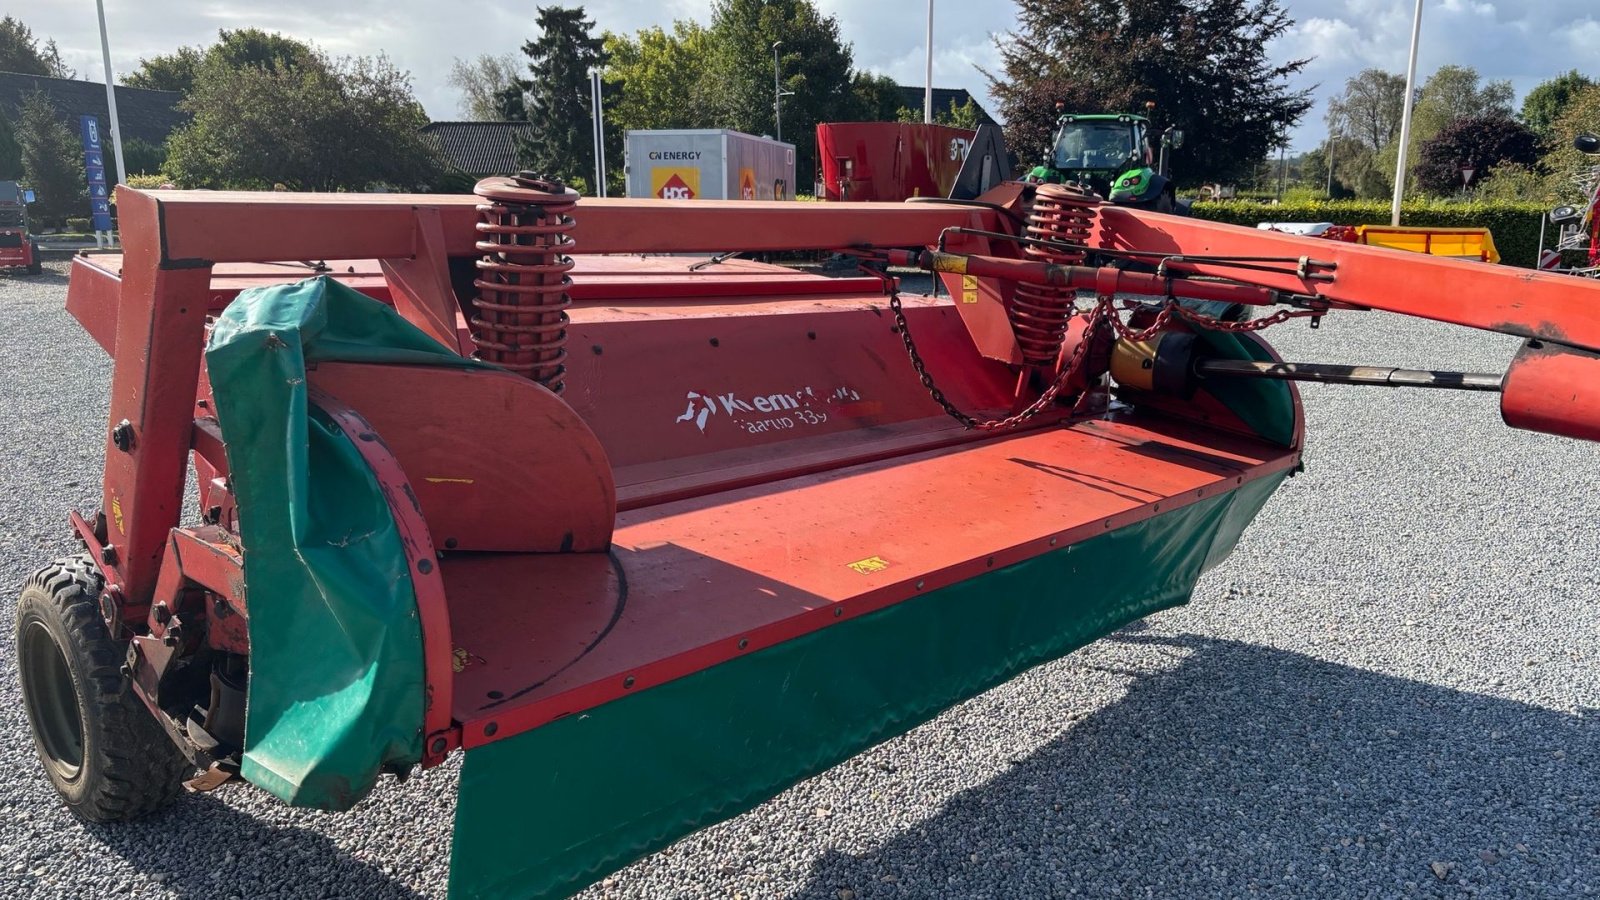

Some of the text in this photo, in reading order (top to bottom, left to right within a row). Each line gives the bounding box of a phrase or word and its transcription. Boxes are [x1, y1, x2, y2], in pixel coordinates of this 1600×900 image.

[663, 151, 702, 161] ENERGY
[663, 186, 689, 200] HDG
[734, 416, 795, 434] aarup
